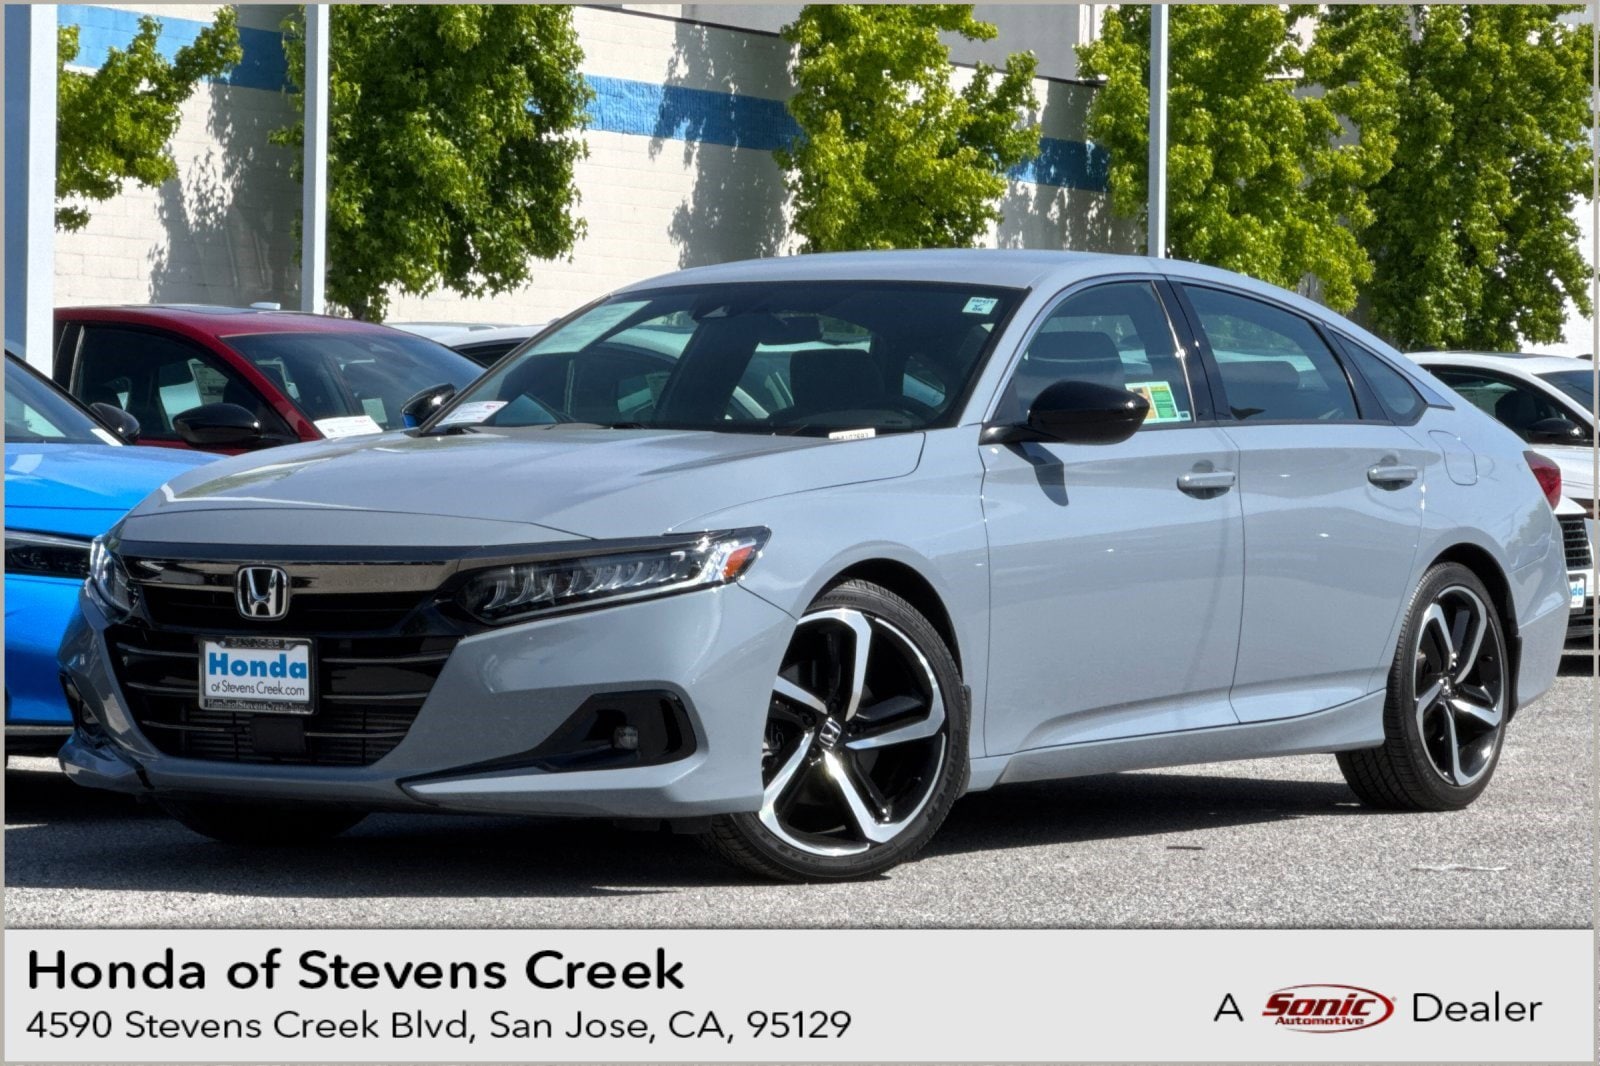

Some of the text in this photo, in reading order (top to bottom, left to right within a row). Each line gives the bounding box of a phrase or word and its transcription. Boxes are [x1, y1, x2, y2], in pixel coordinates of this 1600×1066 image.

[209, 652, 307, 679] Honda
[211, 680, 305, 696] of Stevens Creek.com
